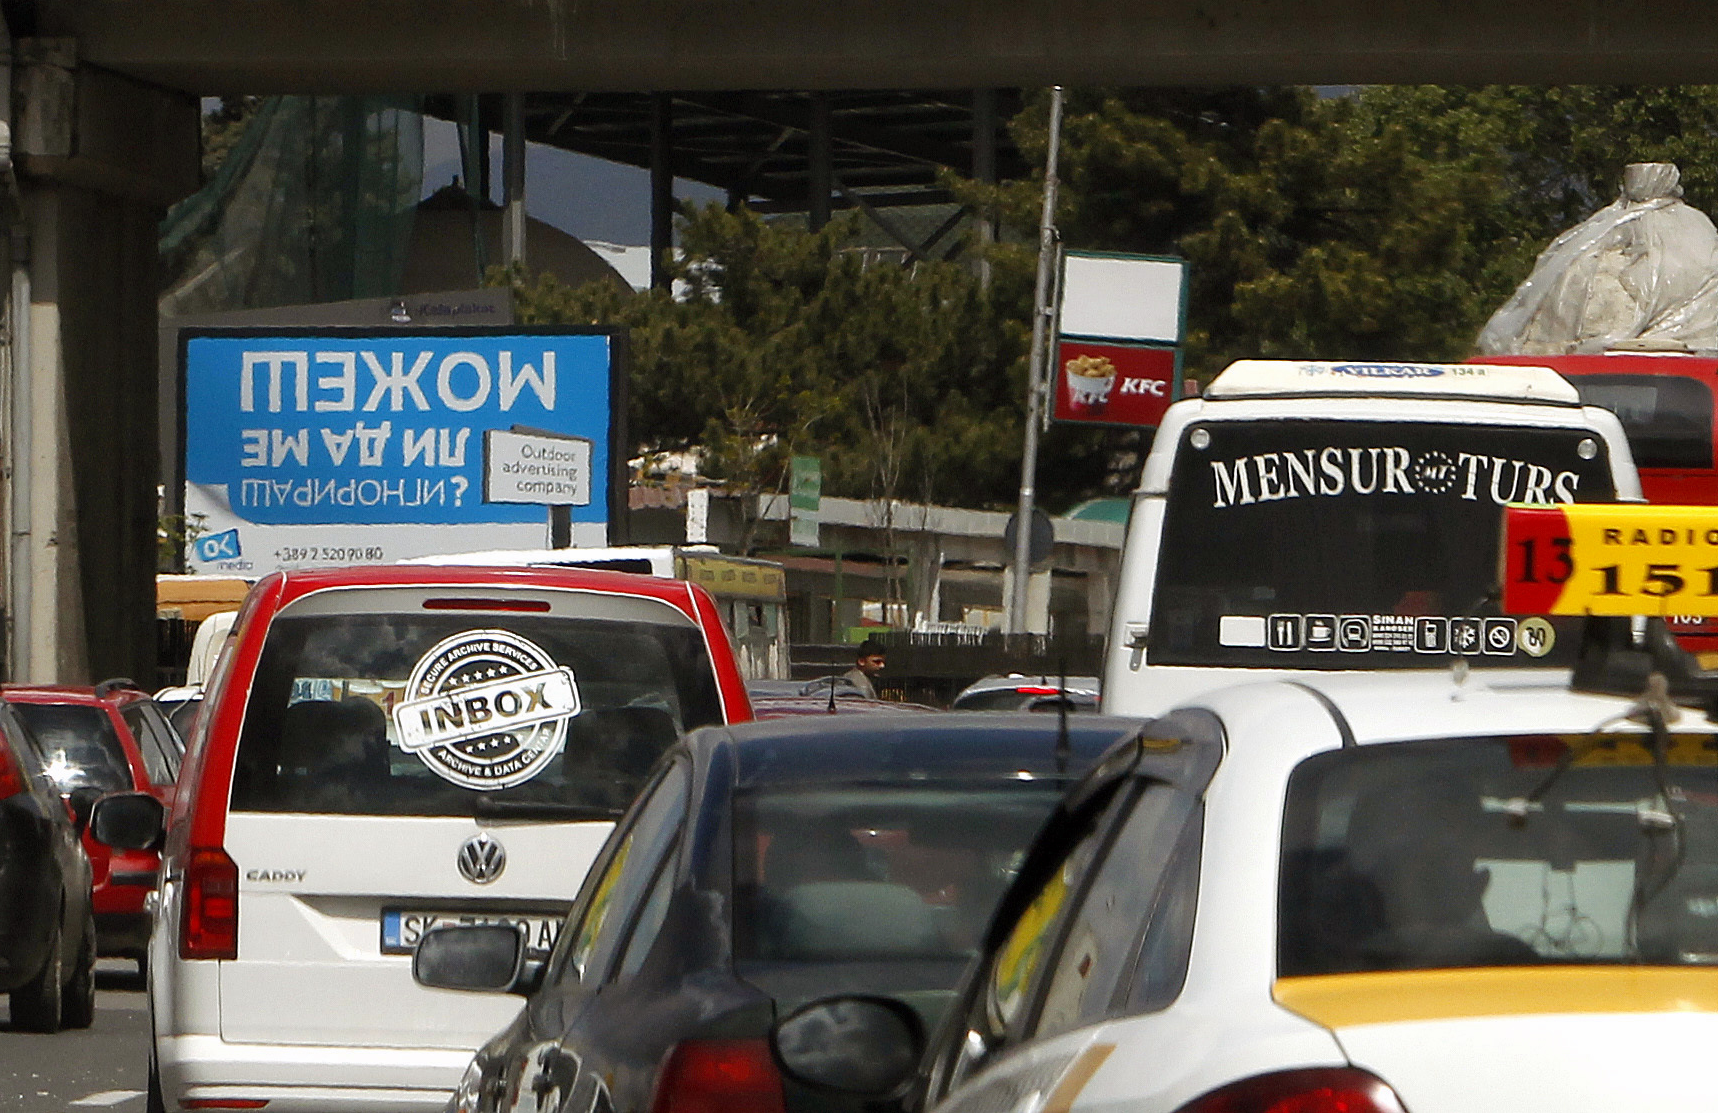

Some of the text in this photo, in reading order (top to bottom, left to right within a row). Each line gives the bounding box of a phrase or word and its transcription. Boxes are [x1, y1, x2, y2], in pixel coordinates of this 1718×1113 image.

[240, 351, 556, 412] МОЖЕШ
[1120, 377, 1166, 396] KFC
[521, 444, 576, 462] Outdoor
[502, 460, 578, 482] advertising
[1210, 446, 1414, 508] MENSUR
[1459, 452, 1580, 505] TURS
[516, 480, 578, 497] company
[1516, 537, 1574, 584] 13
[420, 642, 538, 695] SECURE ARCHIVE SERVICES
[419, 683, 553, 736] INBOX
[438, 749, 482, 776] ARCHIVE
[495, 761, 522, 776] DATA
[246, 870, 306, 882] CADDY
